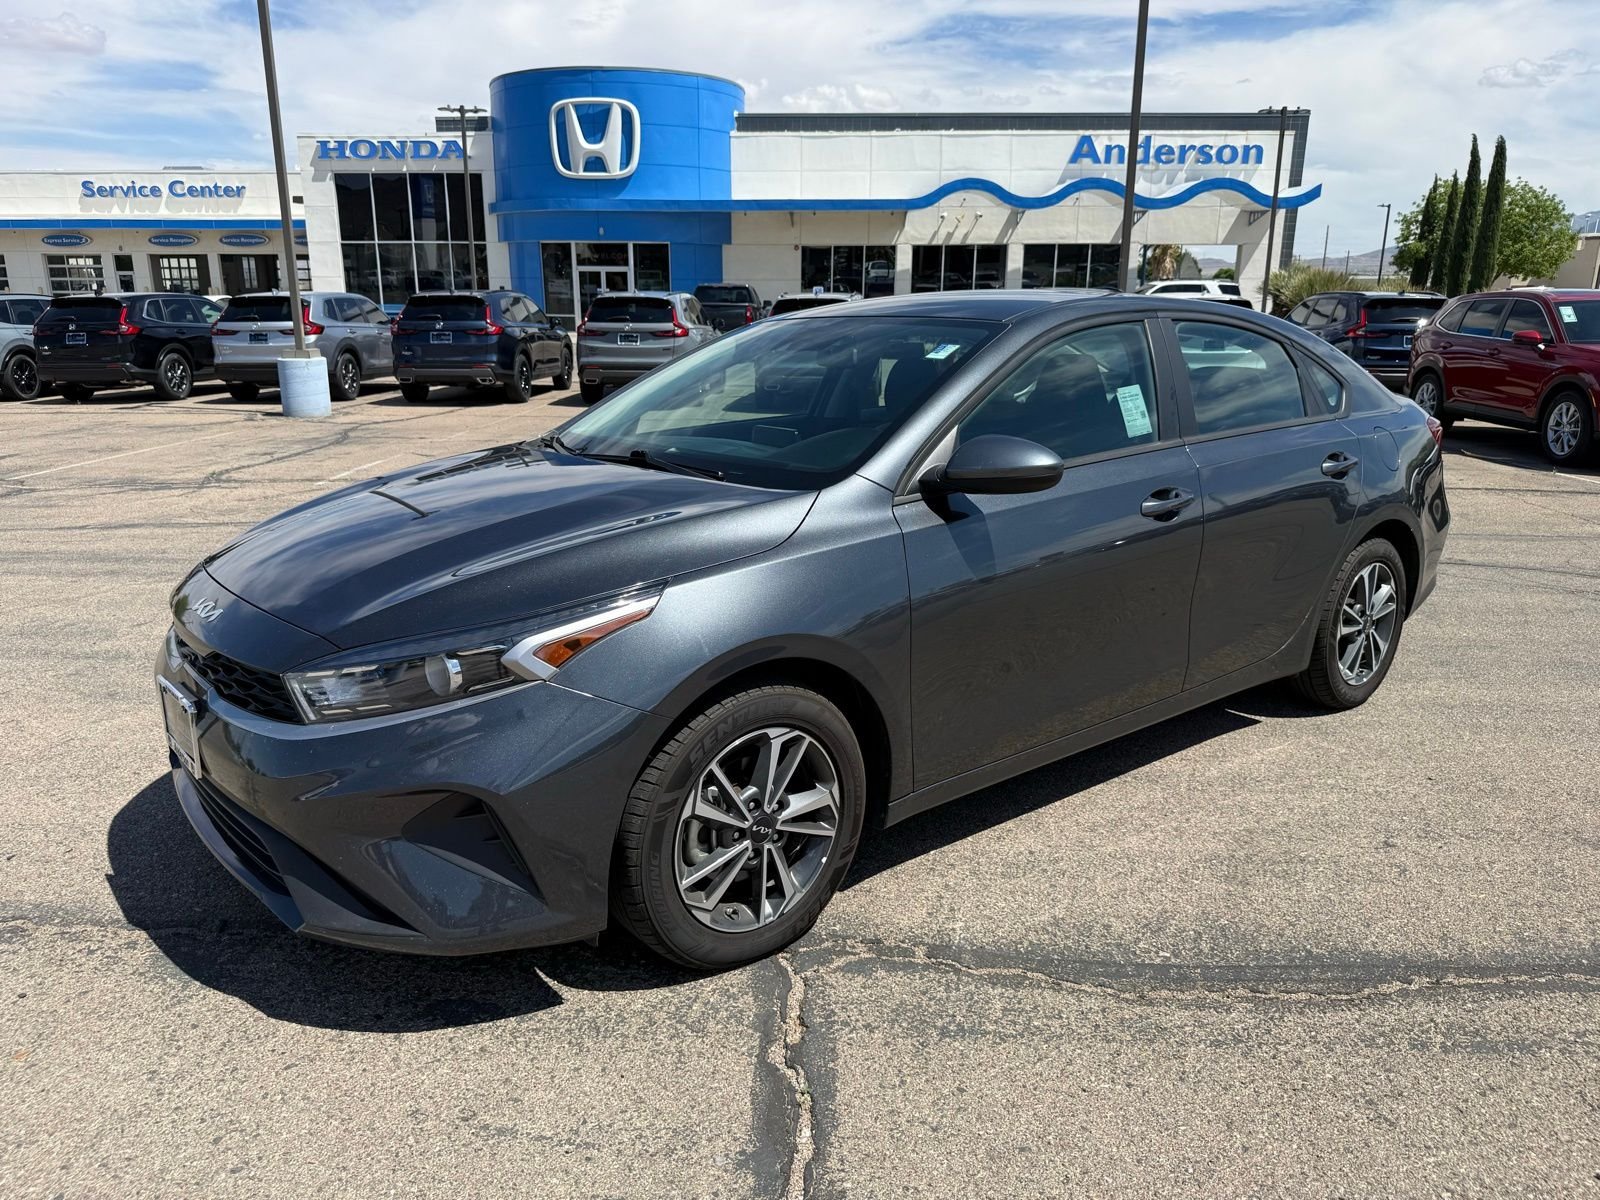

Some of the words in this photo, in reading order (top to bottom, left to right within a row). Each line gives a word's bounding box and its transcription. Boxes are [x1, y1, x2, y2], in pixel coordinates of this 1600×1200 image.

[316, 139, 471, 160] HONDA
[1068, 135, 1264, 165] Anderson
[81, 180, 162, 198] Service
[168, 180, 246, 198] Center
[169, 236, 194, 244] Reception
[240, 236, 265, 244] Reception
[192, 597, 224, 623] KIA
